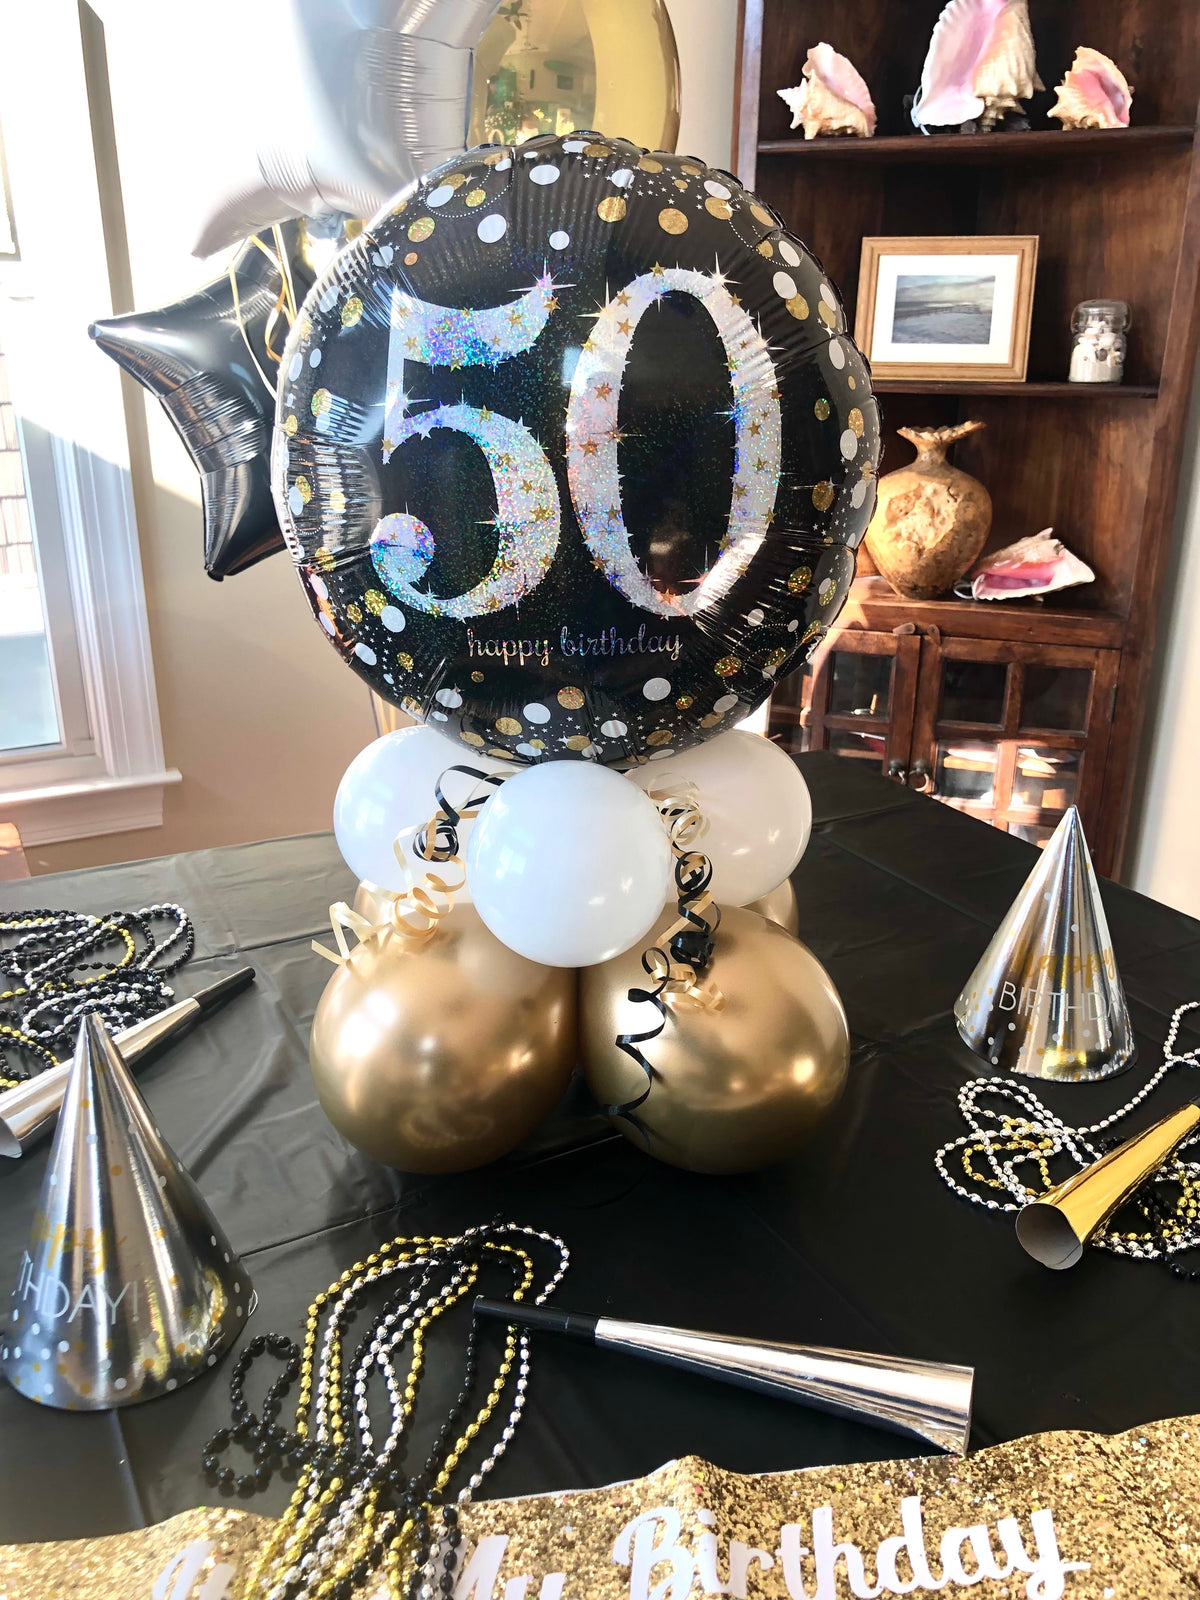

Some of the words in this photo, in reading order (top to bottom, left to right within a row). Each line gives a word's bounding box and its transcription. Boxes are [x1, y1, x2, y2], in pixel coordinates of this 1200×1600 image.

[369, 267, 782, 620] 50
[466, 627, 550, 667] happy
[560, 622, 684, 661] birthday
[998, 980, 1122, 1022] BIRTHDA
[30, 1208, 128, 1275] ppy
[18, 1250, 139, 1325] THDAY!
[612, 1496, 1090, 1600] Birthday
